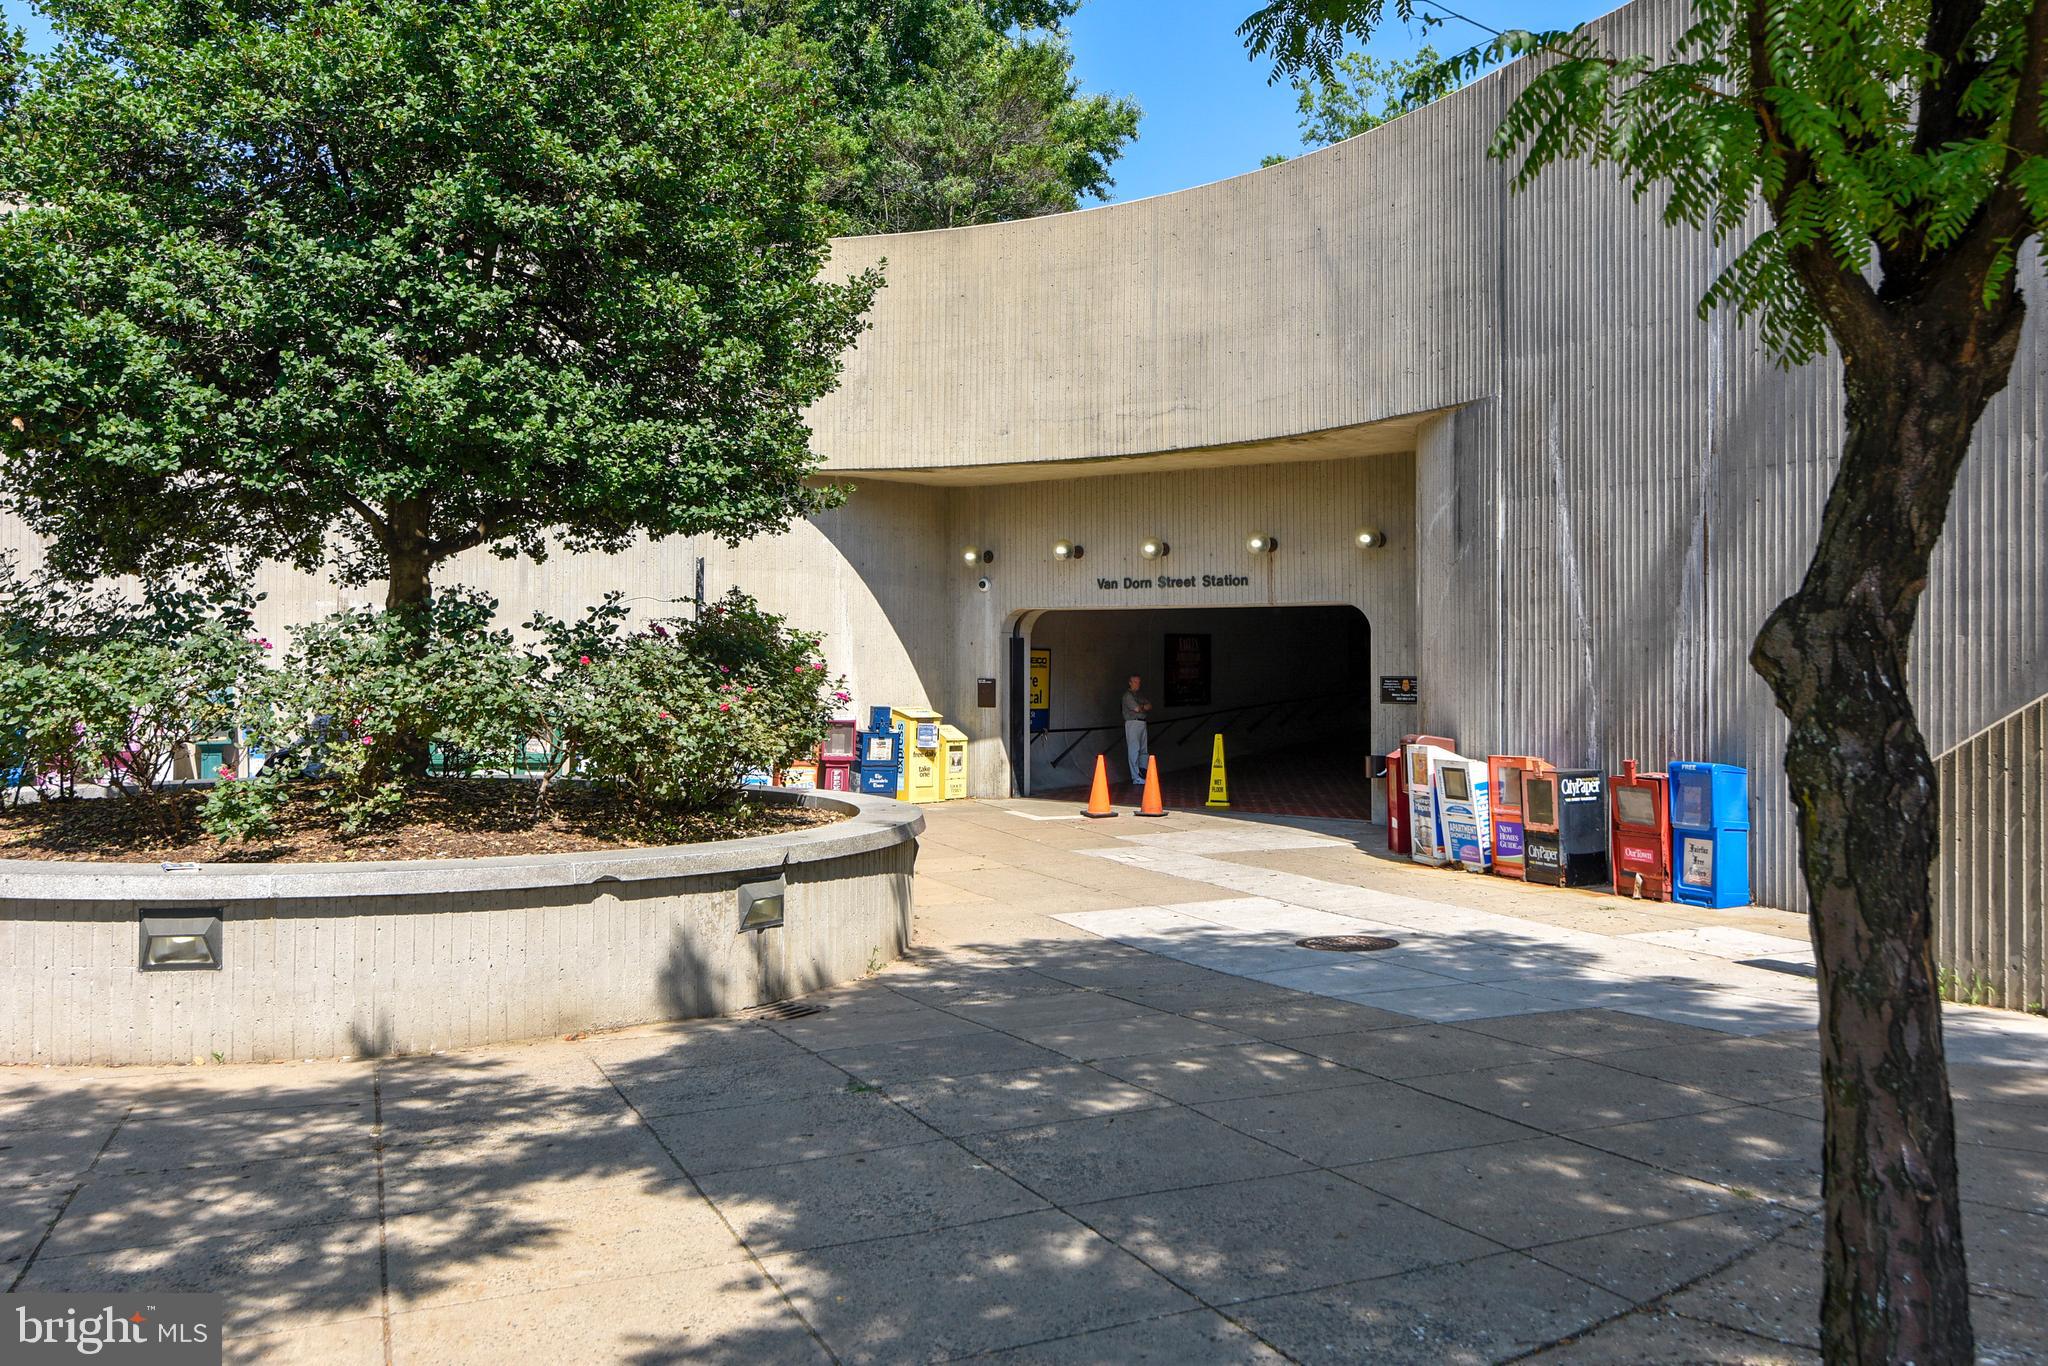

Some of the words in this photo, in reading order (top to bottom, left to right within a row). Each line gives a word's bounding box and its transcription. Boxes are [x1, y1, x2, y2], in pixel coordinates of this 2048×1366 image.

[1097, 578, 1118, 589] Van
[1123, 577, 1152, 589] Dorn
[1157, 575, 1196, 588] Street
[1202, 574, 1249, 587] Station
[1030, 656, 1048, 665] EICO
[1499, 825, 1513, 833] NEW
[1500, 833, 1519, 841] HOMES
